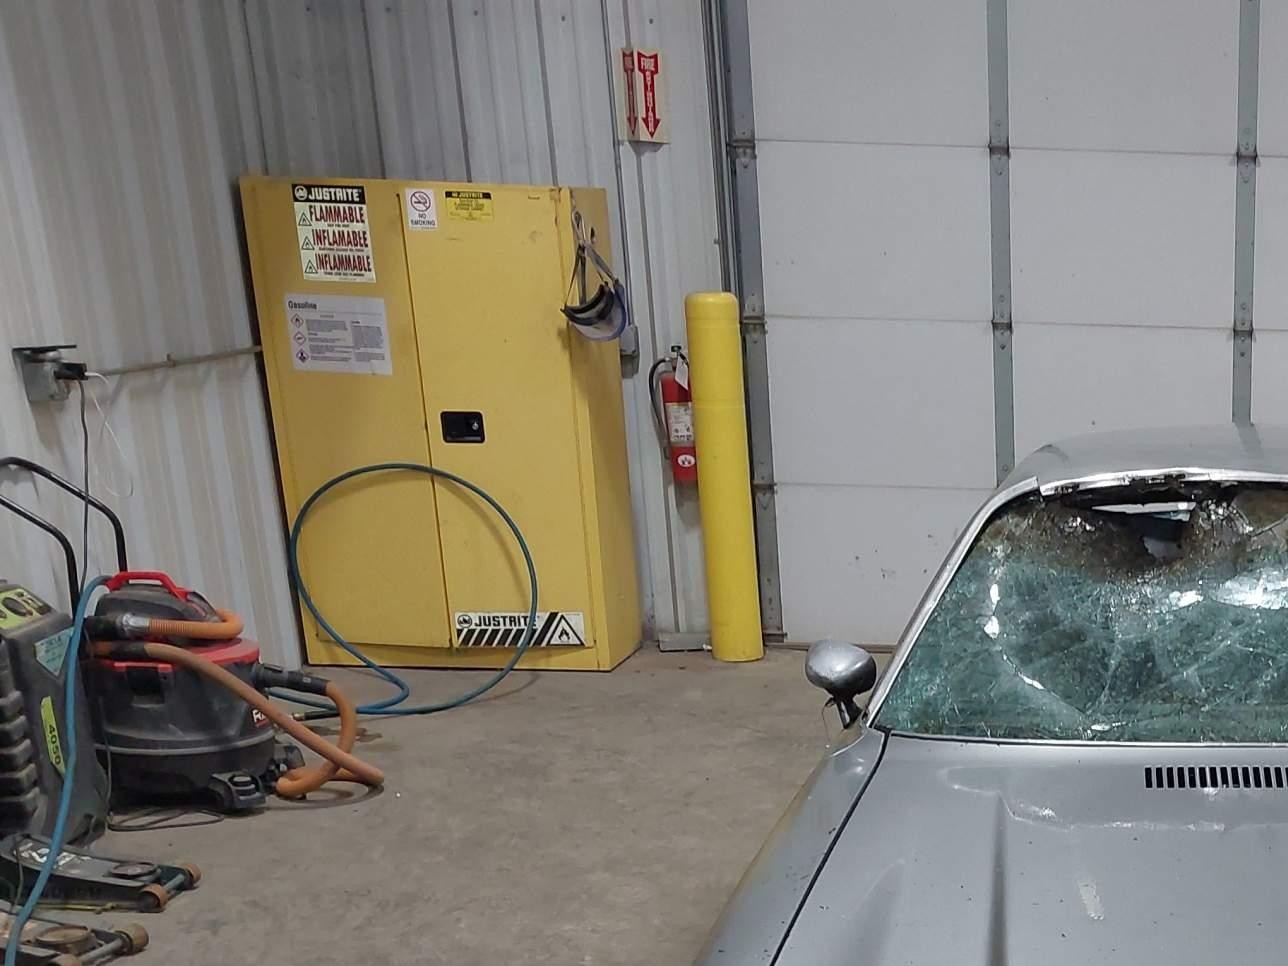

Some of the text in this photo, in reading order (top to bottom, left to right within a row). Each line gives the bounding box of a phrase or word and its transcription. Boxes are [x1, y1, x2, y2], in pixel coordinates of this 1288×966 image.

[308, 187, 360, 202] JUSTRITE
[309, 205, 365, 224] FLAMMABLE
[312, 228, 369, 248] INFLAMABLE
[315, 253, 372, 273] INFLAMMABLE
[288, 300, 317, 310] Gasoline
